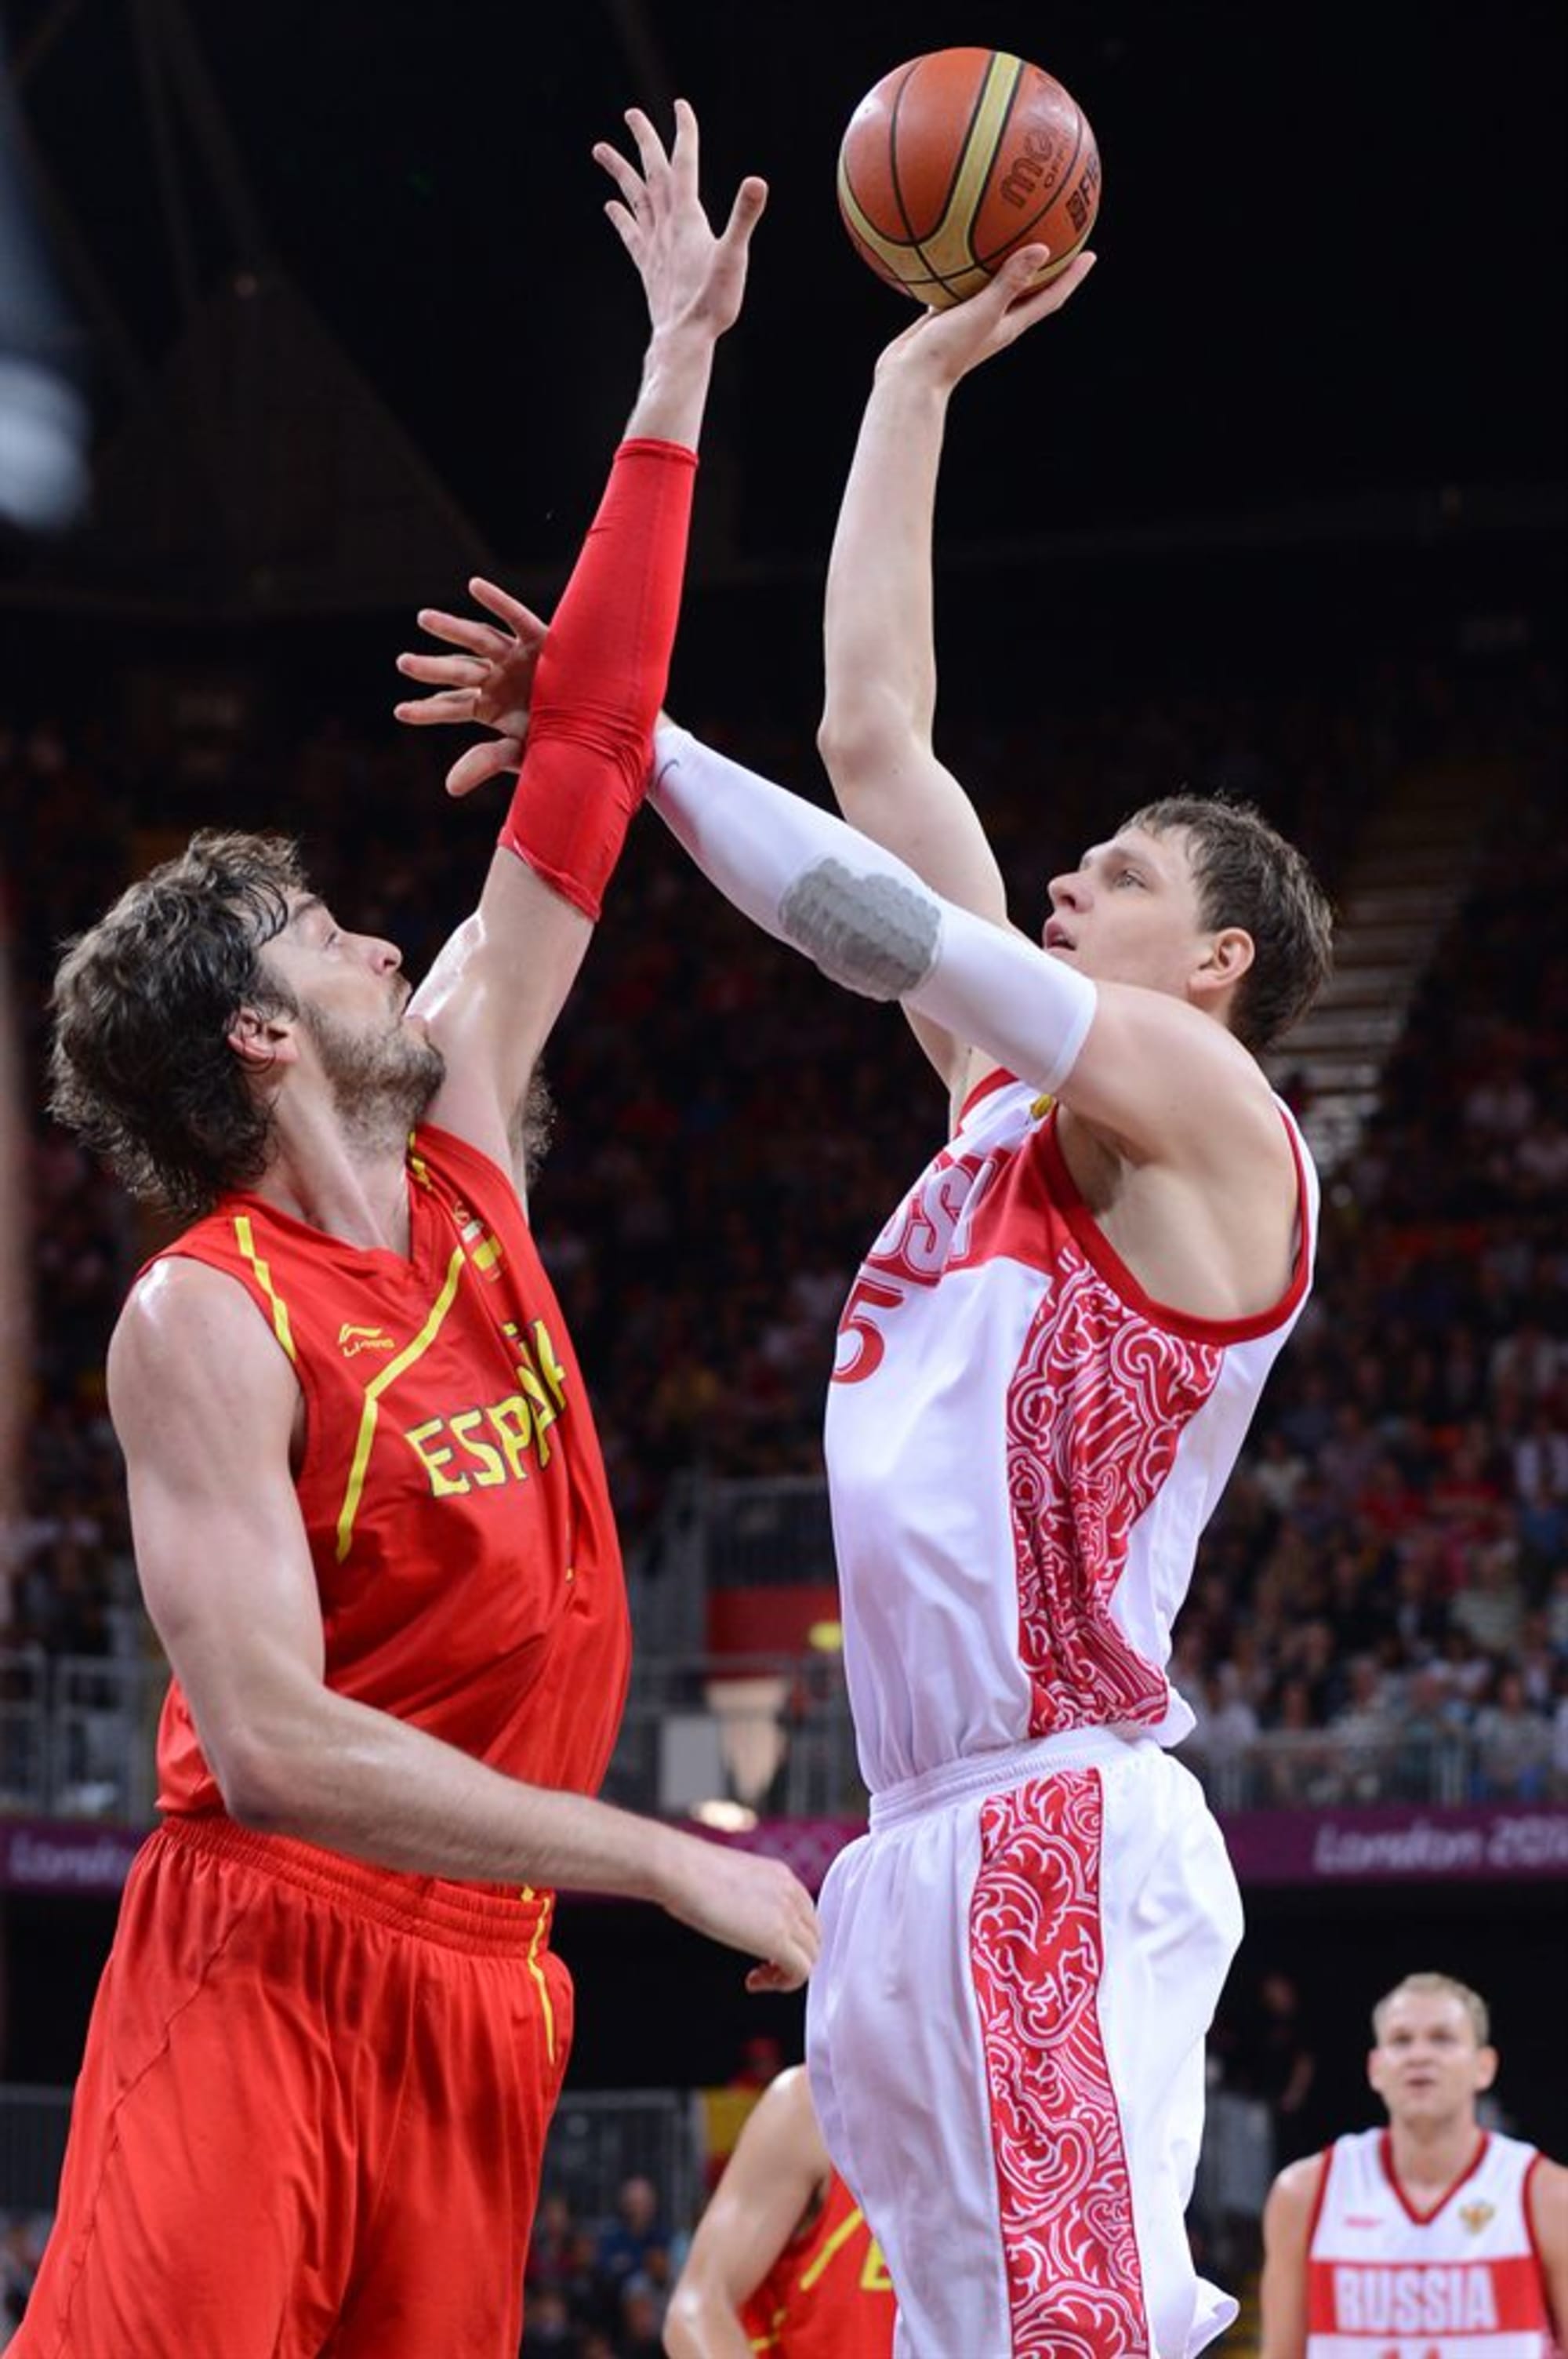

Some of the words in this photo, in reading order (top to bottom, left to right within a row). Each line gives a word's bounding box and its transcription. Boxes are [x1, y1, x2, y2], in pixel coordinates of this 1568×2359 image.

[404, 1319, 567, 1498] ESPA
[11, 1830, 130, 1884] Lond
[1487, 1812, 1568, 1868] 201
[1335, 2263, 1498, 2332] RUSSIA
